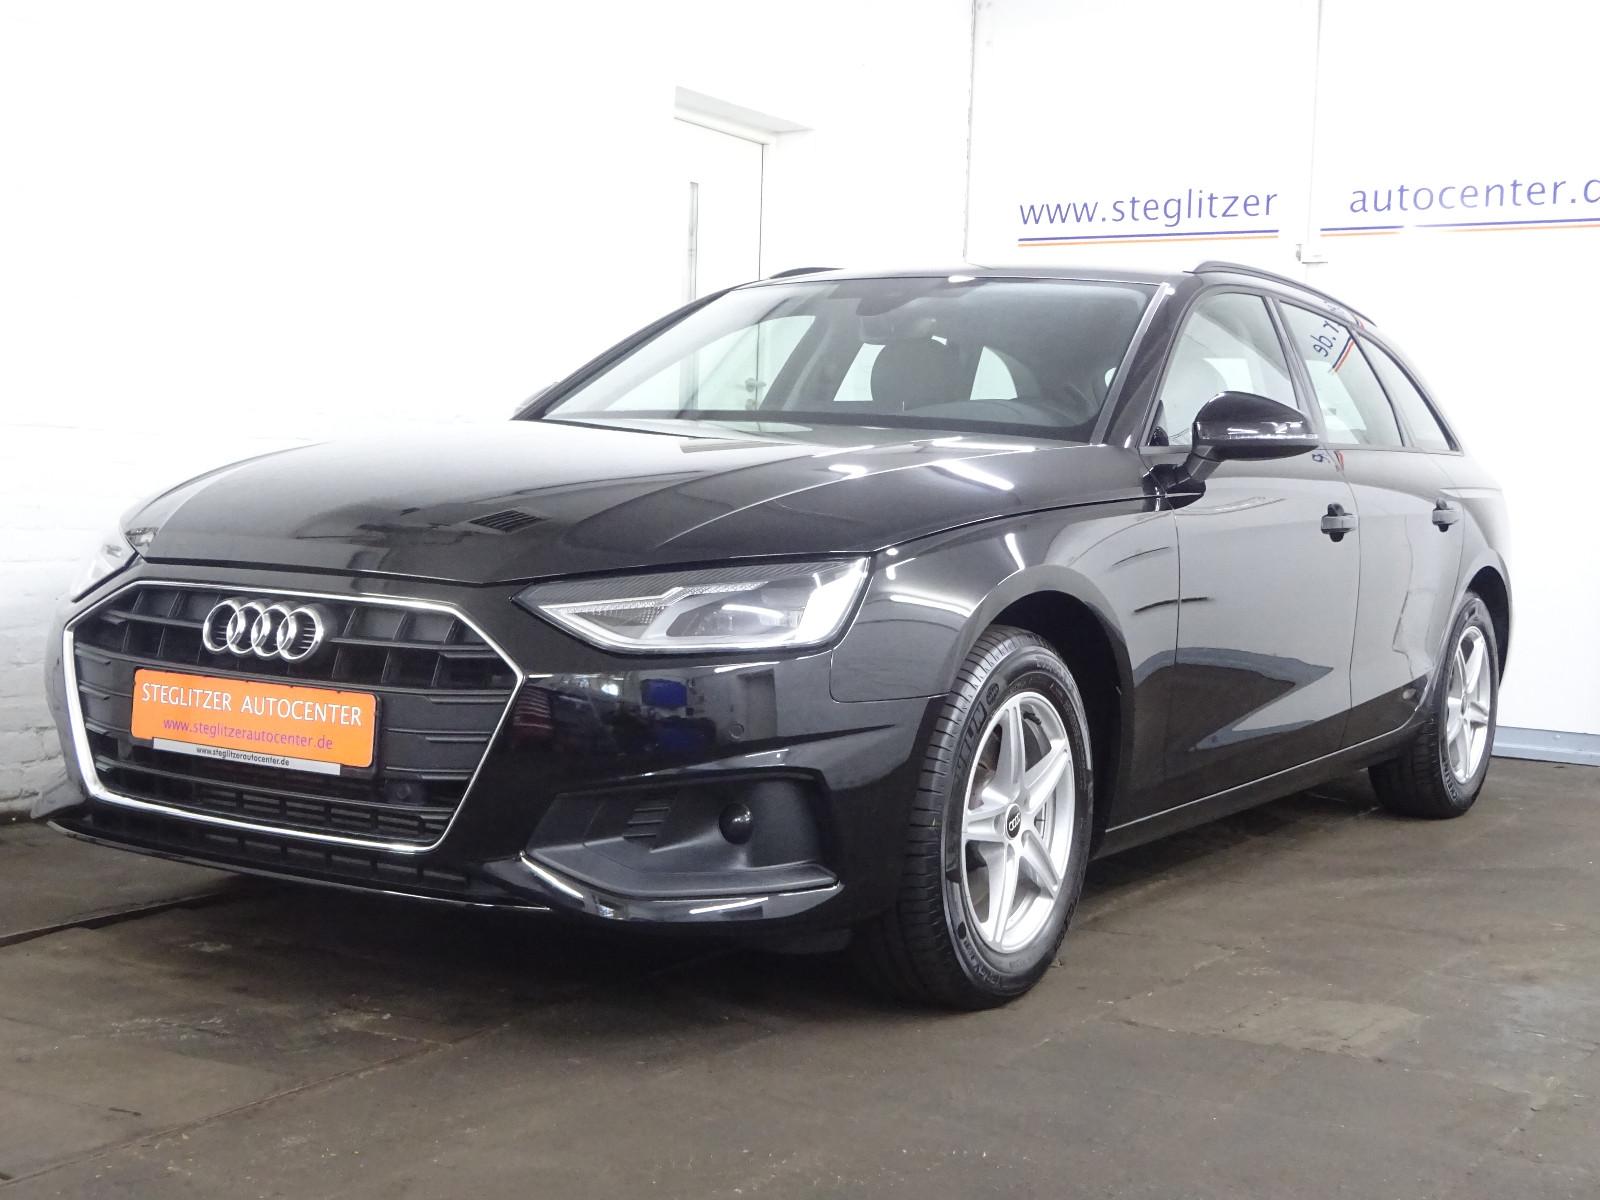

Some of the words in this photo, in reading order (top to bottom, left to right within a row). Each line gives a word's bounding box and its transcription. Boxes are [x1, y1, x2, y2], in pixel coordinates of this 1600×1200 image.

[1019, 188, 1278, 228] www.steglitzer
[141, 682, 232, 712] STEGLITZER
[241, 695, 362, 726] AUTOCENTER
[162, 717, 334, 750] www.steglitzerautocenter.de
[195, 746, 290, 767] www.steglitzerautocenter.de
